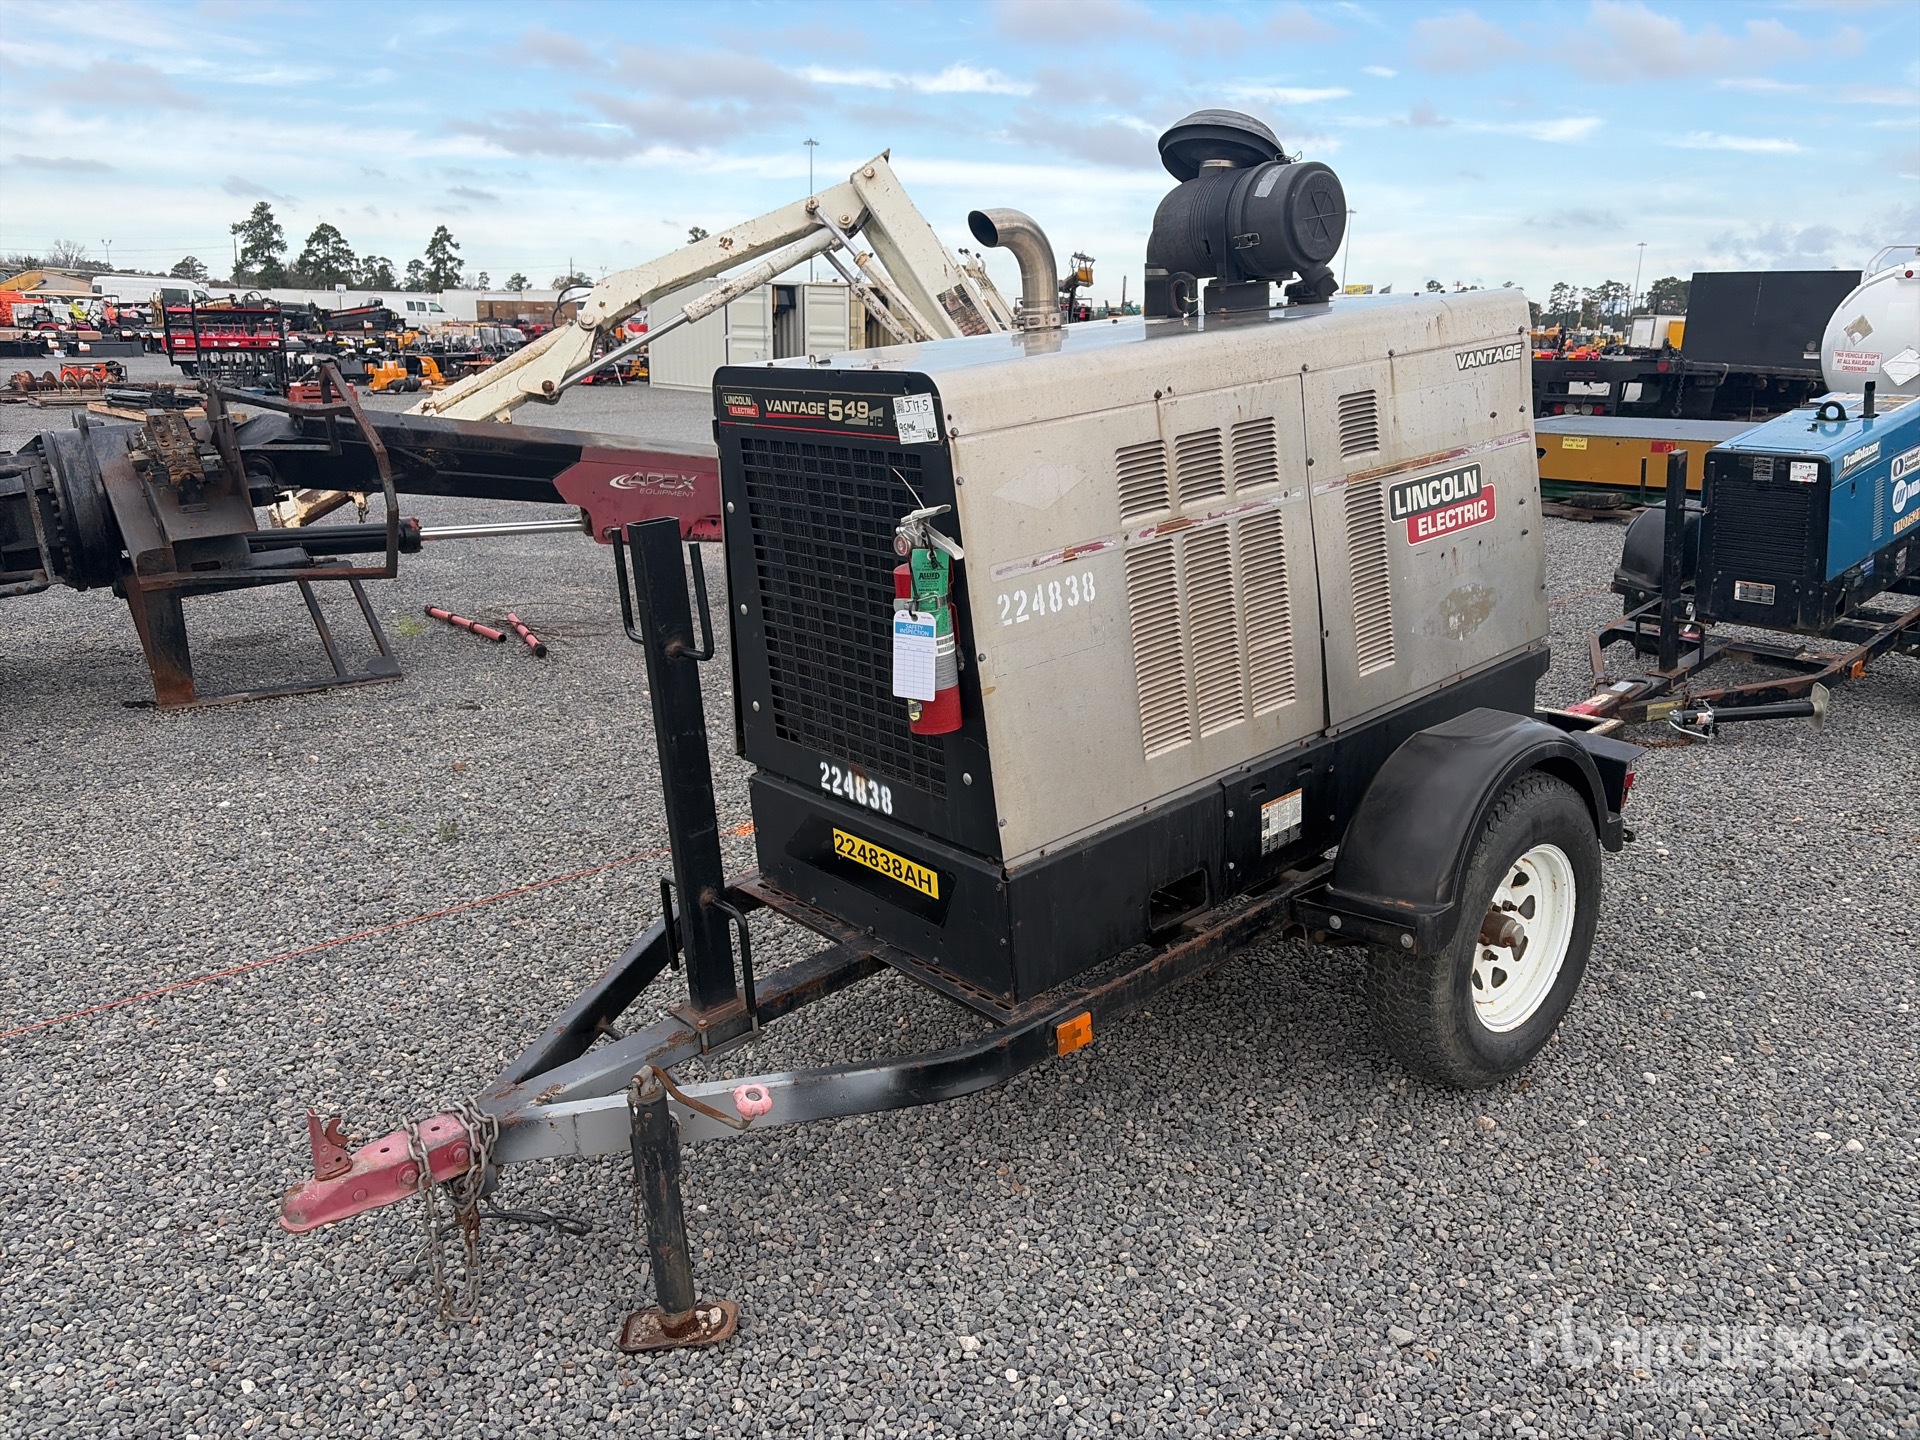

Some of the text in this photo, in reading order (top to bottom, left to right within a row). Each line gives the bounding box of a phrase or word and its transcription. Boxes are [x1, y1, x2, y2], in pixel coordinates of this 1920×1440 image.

[1456, 343, 1522, 370] VANTAGE
[724, 395, 752, 406] LINCOLN
[731, 406, 756, 415] ELECTRIC
[765, 399, 825, 415] VANTAGE
[828, 398, 869, 421] 549
[1843, 441, 1880, 468] Trailblazer
[625, 471, 698, 490] APEX
[1394, 469, 1478, 515] LINCOLN
[640, 488, 697, 497] EQUIPMENT
[1417, 500, 1488, 537] ELECTRIC
[919, 572, 940, 580] ALLIED
[997, 571, 1096, 626] 224838
[899, 628, 930, 637] INSPECTION
[905, 623, 924, 631] SAFETY
[820, 761, 893, 815] 224838
[834, 833, 933, 894] 224838AH
